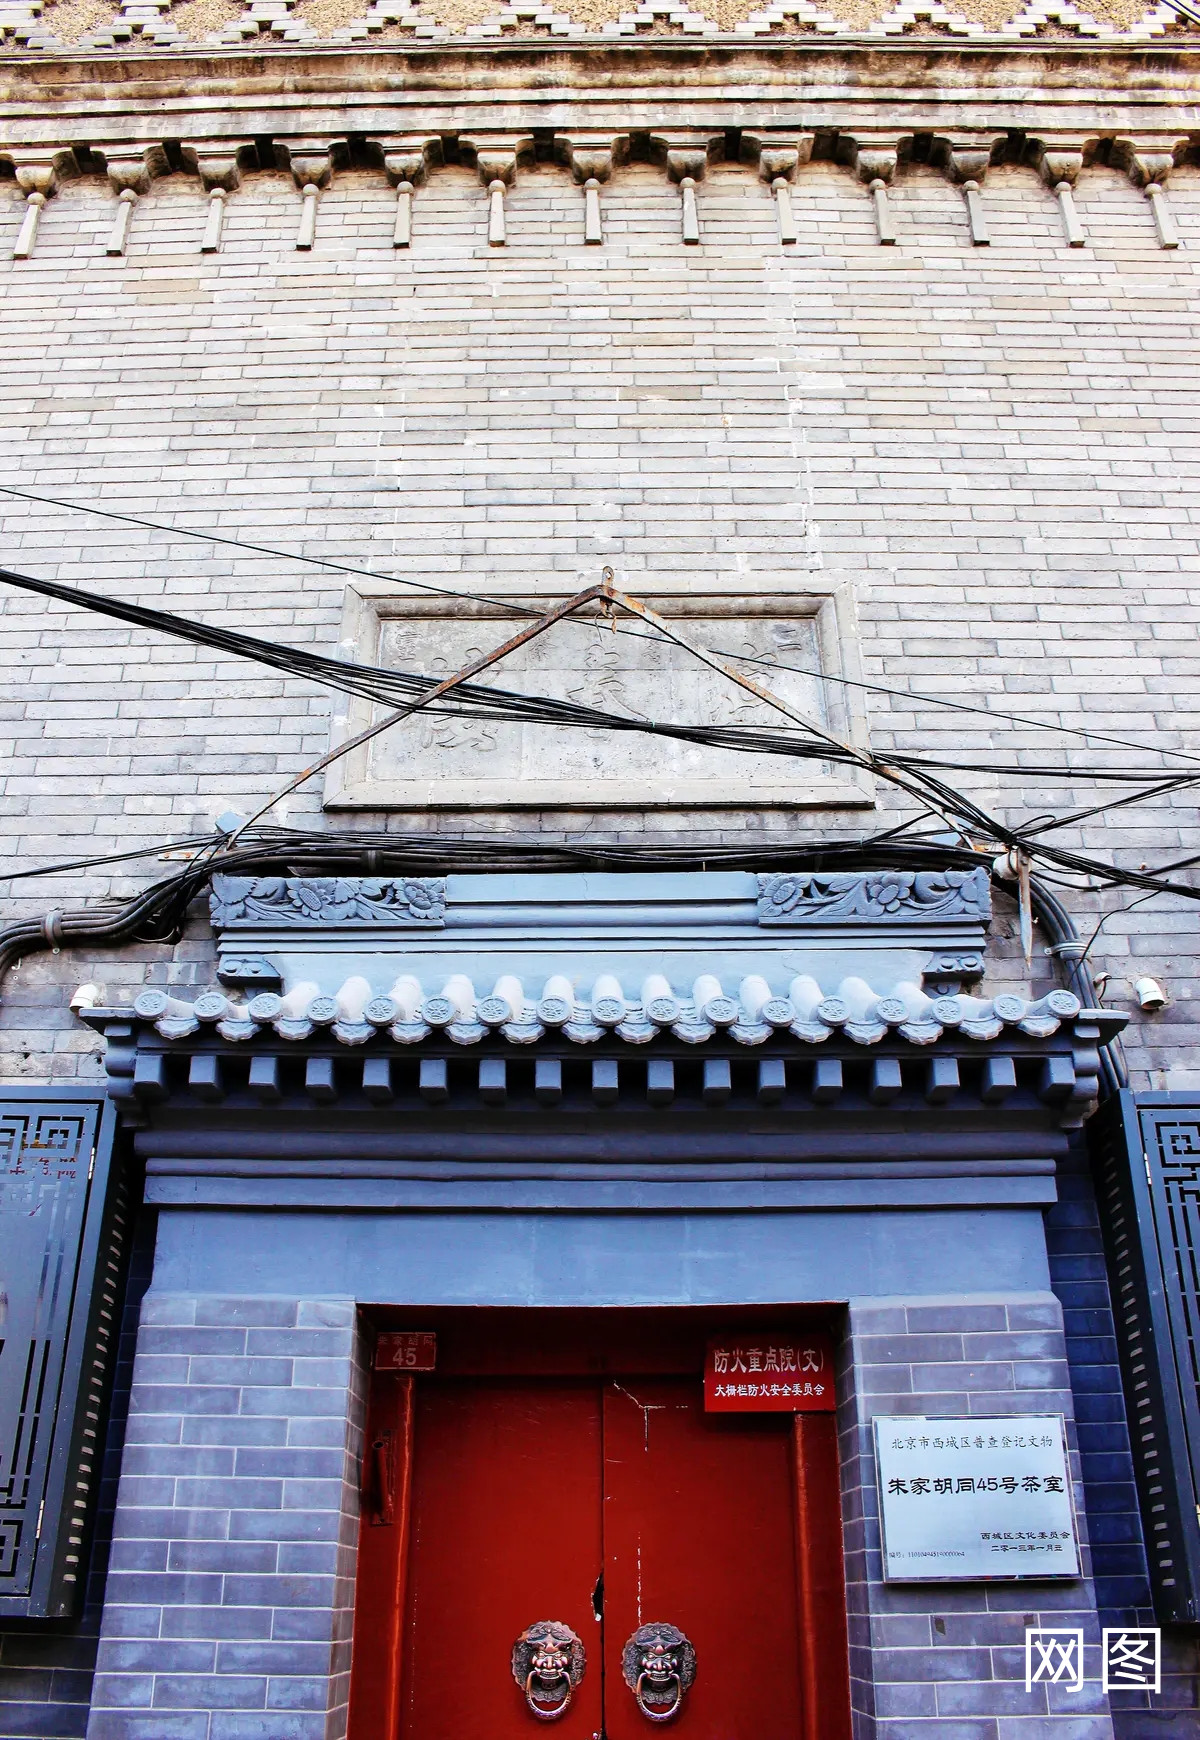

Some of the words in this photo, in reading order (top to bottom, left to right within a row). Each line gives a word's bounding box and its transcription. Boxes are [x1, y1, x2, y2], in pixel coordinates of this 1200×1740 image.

[392, 1347, 417, 1366] 45
[714, 1383, 825, 1397] 大栅栏防火安全委员会
[892, 1435, 1053, 1450] 北京市西城区普查登记文物
[888, 1475, 1065, 1495] 朱家胡同45号茶室
[980, 1531, 1070, 1540] 西城区文化委员会
